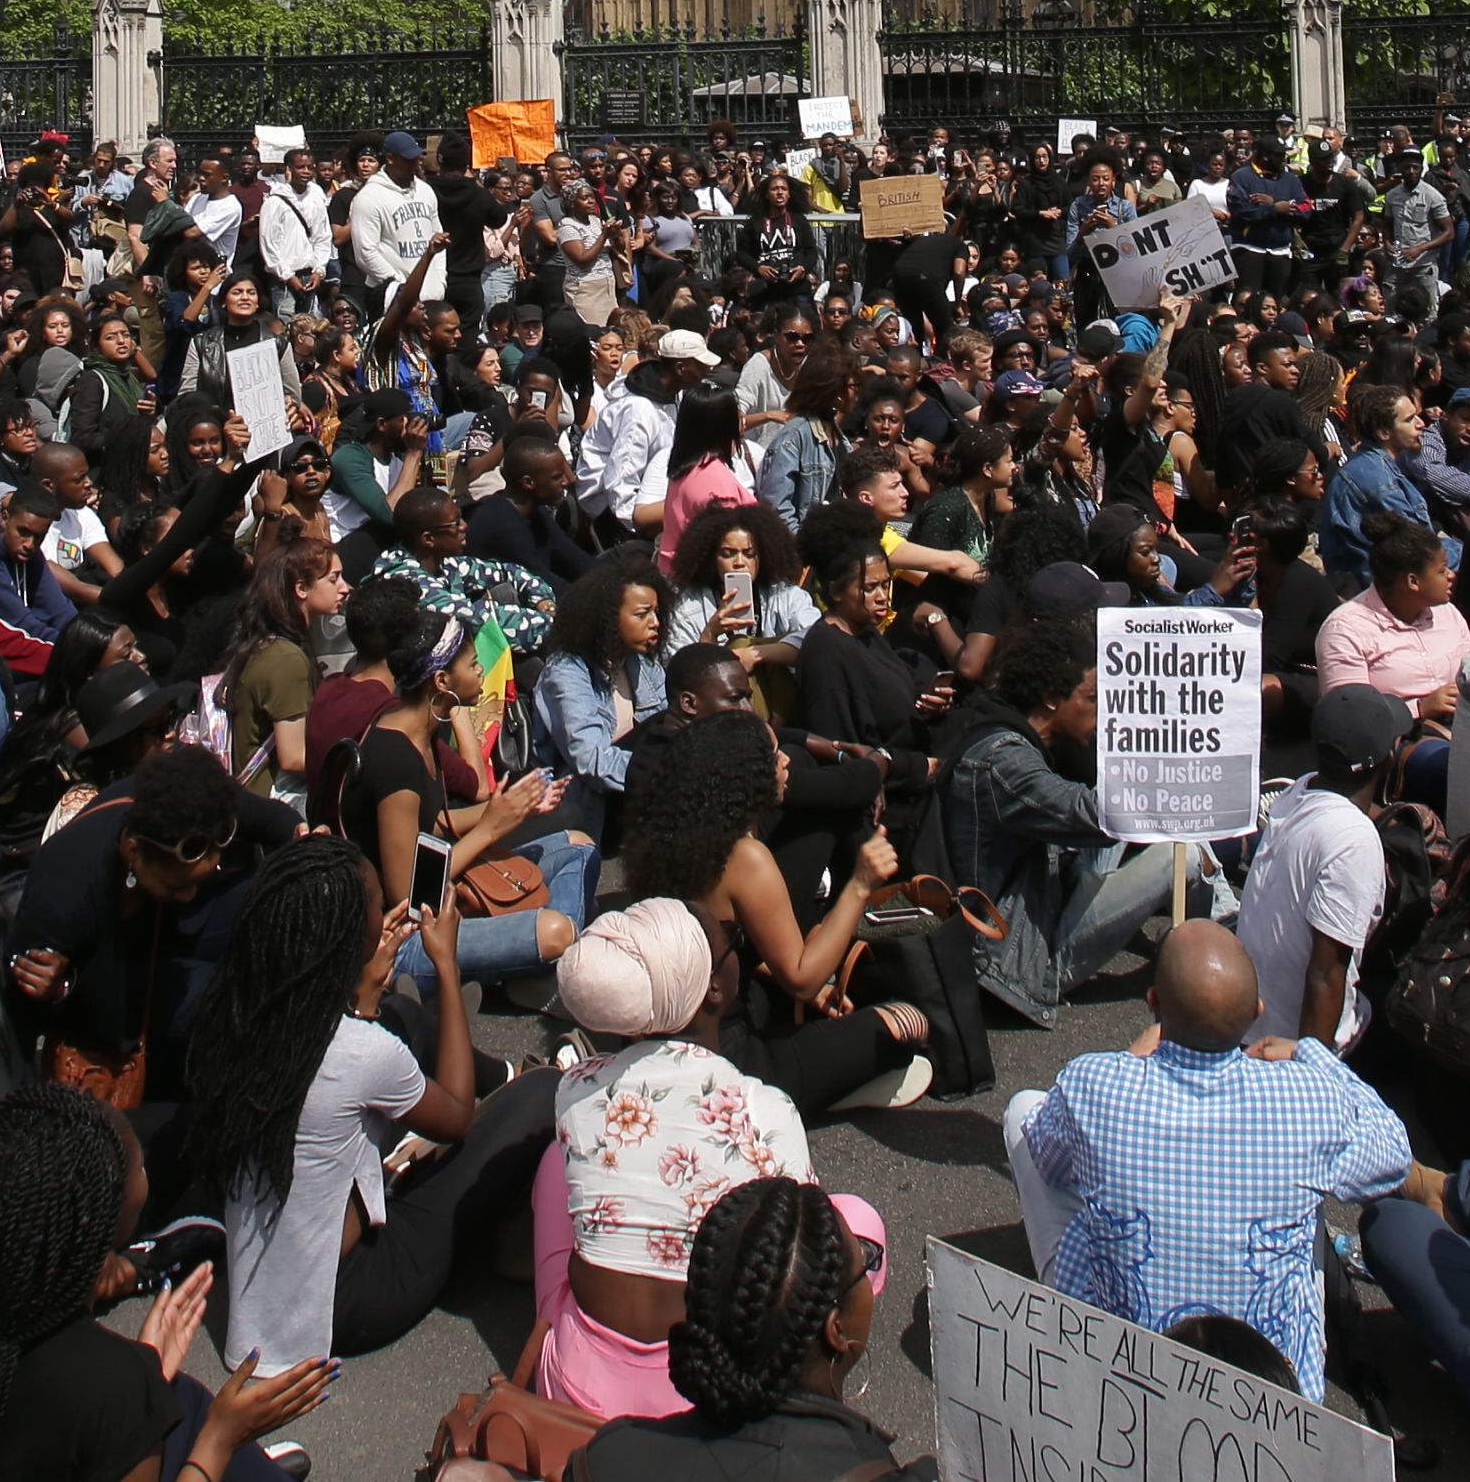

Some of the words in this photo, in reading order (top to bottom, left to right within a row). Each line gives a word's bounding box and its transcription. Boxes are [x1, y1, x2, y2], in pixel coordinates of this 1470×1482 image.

[809, 101, 843, 113] PROTECT
[806, 120, 851, 133] MANDEM
[877, 191, 920, 208] BRITISH
[1125, 620, 1185, 634] Socialist
[1187, 621, 1234, 634] Worker
[1105, 641, 1246, 683] Solidarity
[1105, 680, 1165, 714] with
[1178, 681, 1224, 715] the
[1105, 718, 1221, 753] families
[1123, 759, 1149, 783] No
[1155, 761, 1223, 784] Justice
[1123, 788, 1149, 811] No
[1156, 789, 1213, 812] Peace
[1134, 815, 1215, 831] www.swp.org.uk
[957, 1313, 1073, 1429] THE
[974, 1269, 1102, 1362] WE'RE
[1110, 1328, 1168, 1387] ALL
[1172, 1352, 1226, 1409] THE
[1228, 1378, 1322, 1452] SAME
